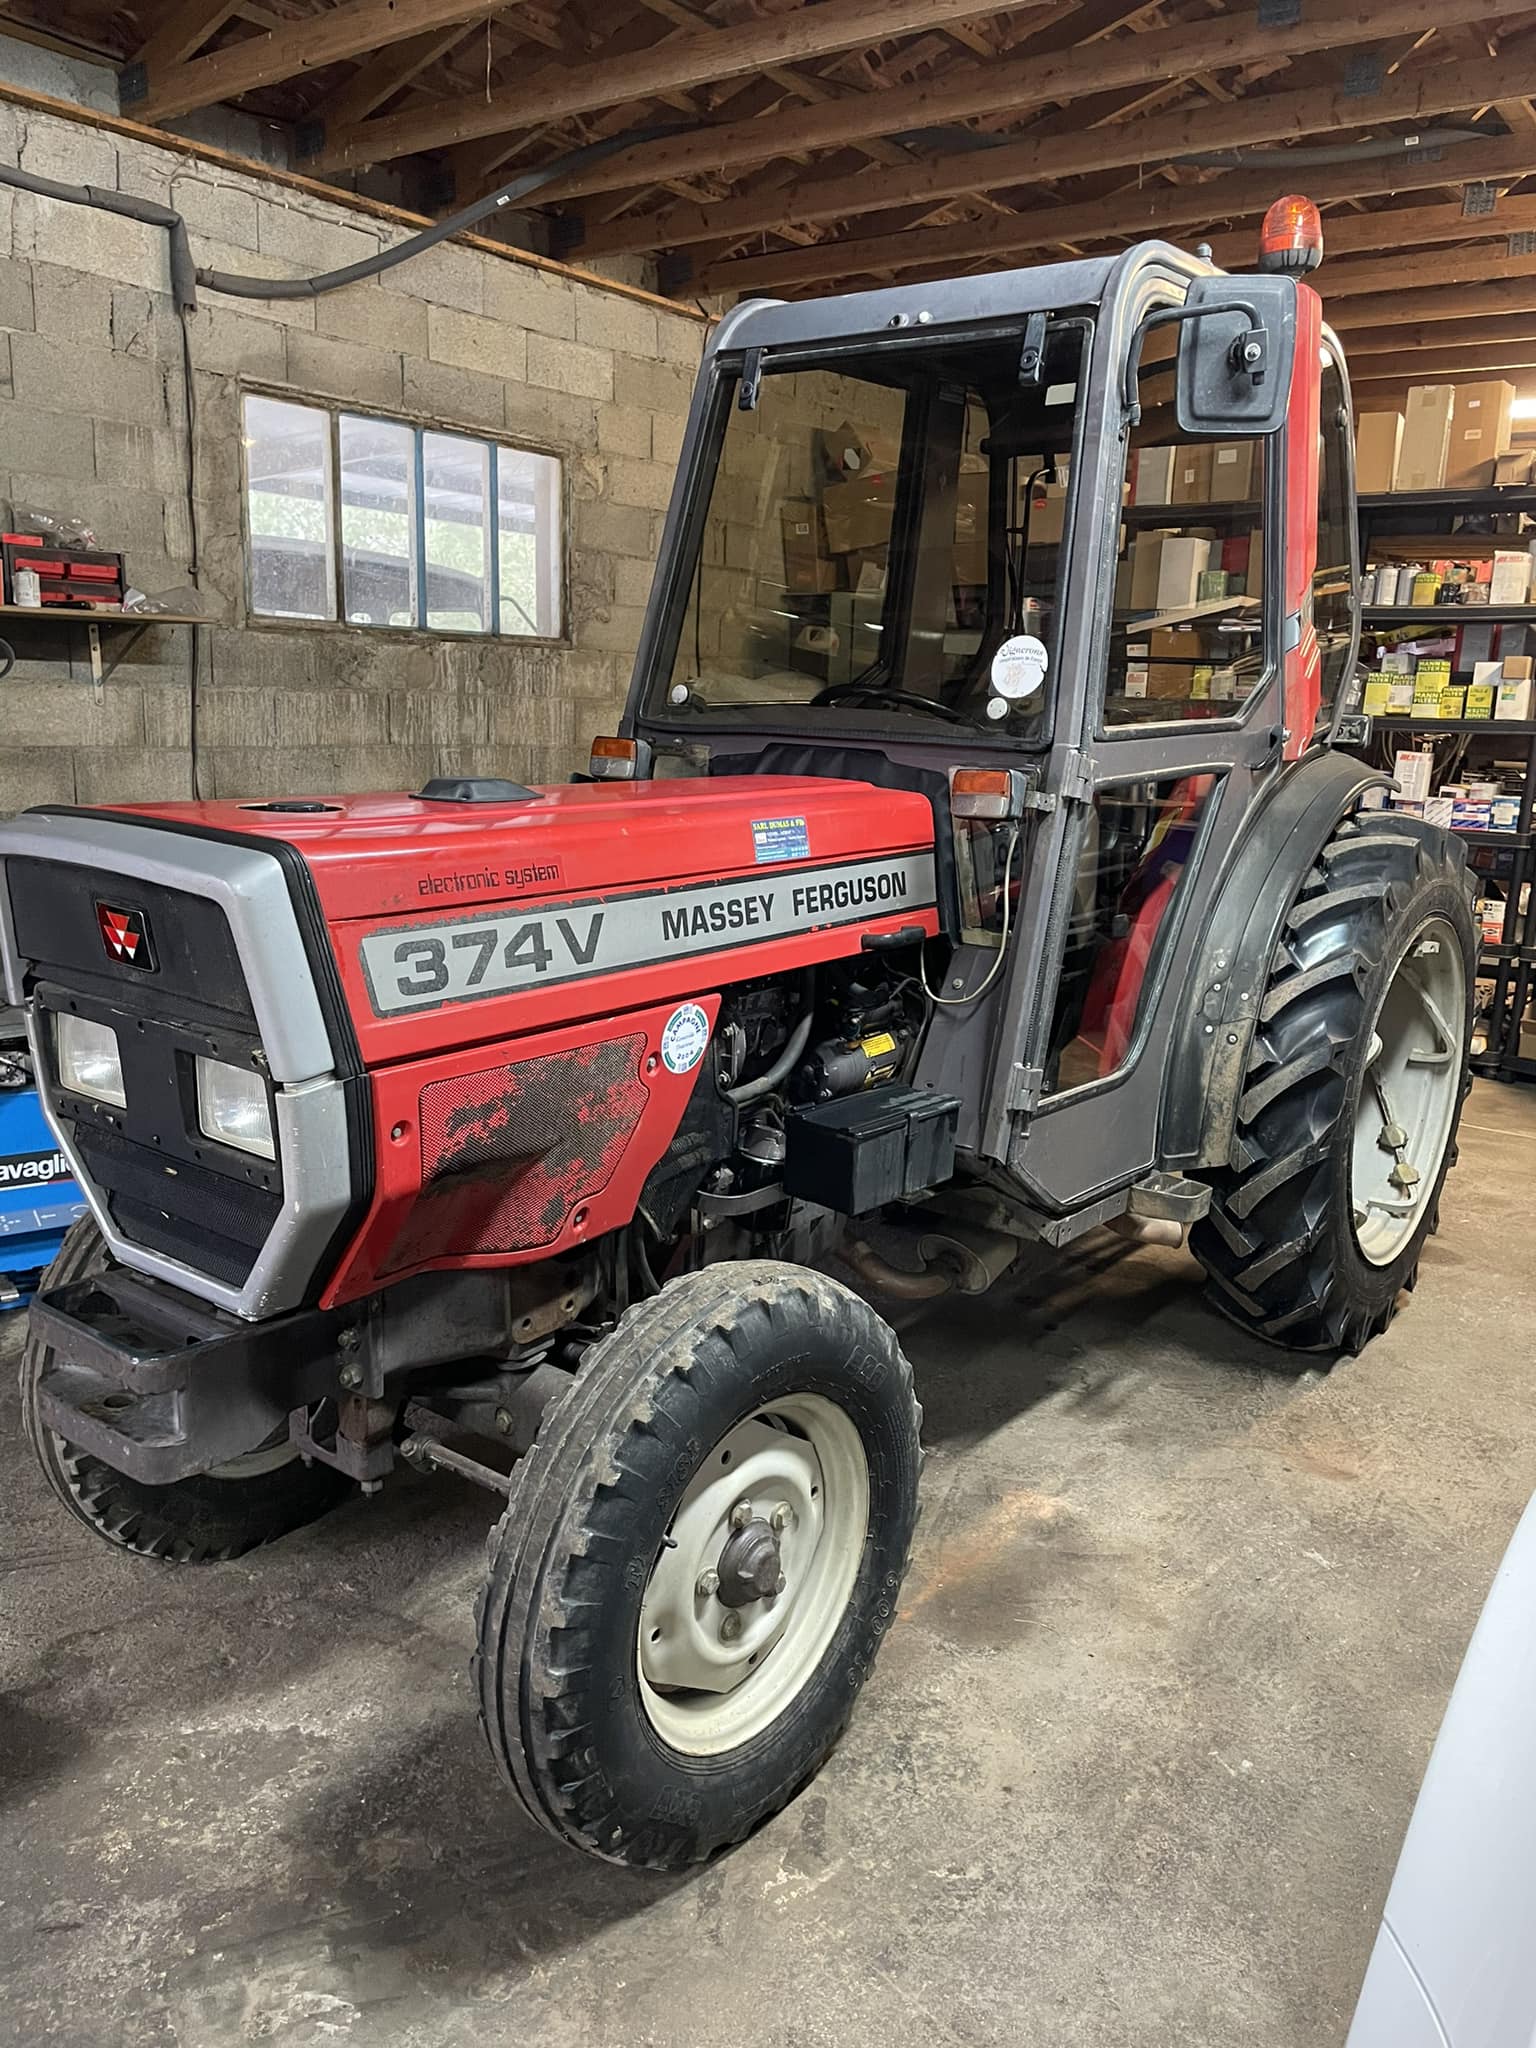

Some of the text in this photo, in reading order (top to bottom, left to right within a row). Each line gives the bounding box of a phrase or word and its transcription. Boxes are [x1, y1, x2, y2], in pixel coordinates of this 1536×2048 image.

[418, 863, 560, 896] electronic system
[661, 871, 907, 941] MASSEY FERGUSON
[394, 912, 605, 997] 374V
[671, 1016, 701, 1042] CAMPAGNE
[0, 1153, 72, 1181] avagli
